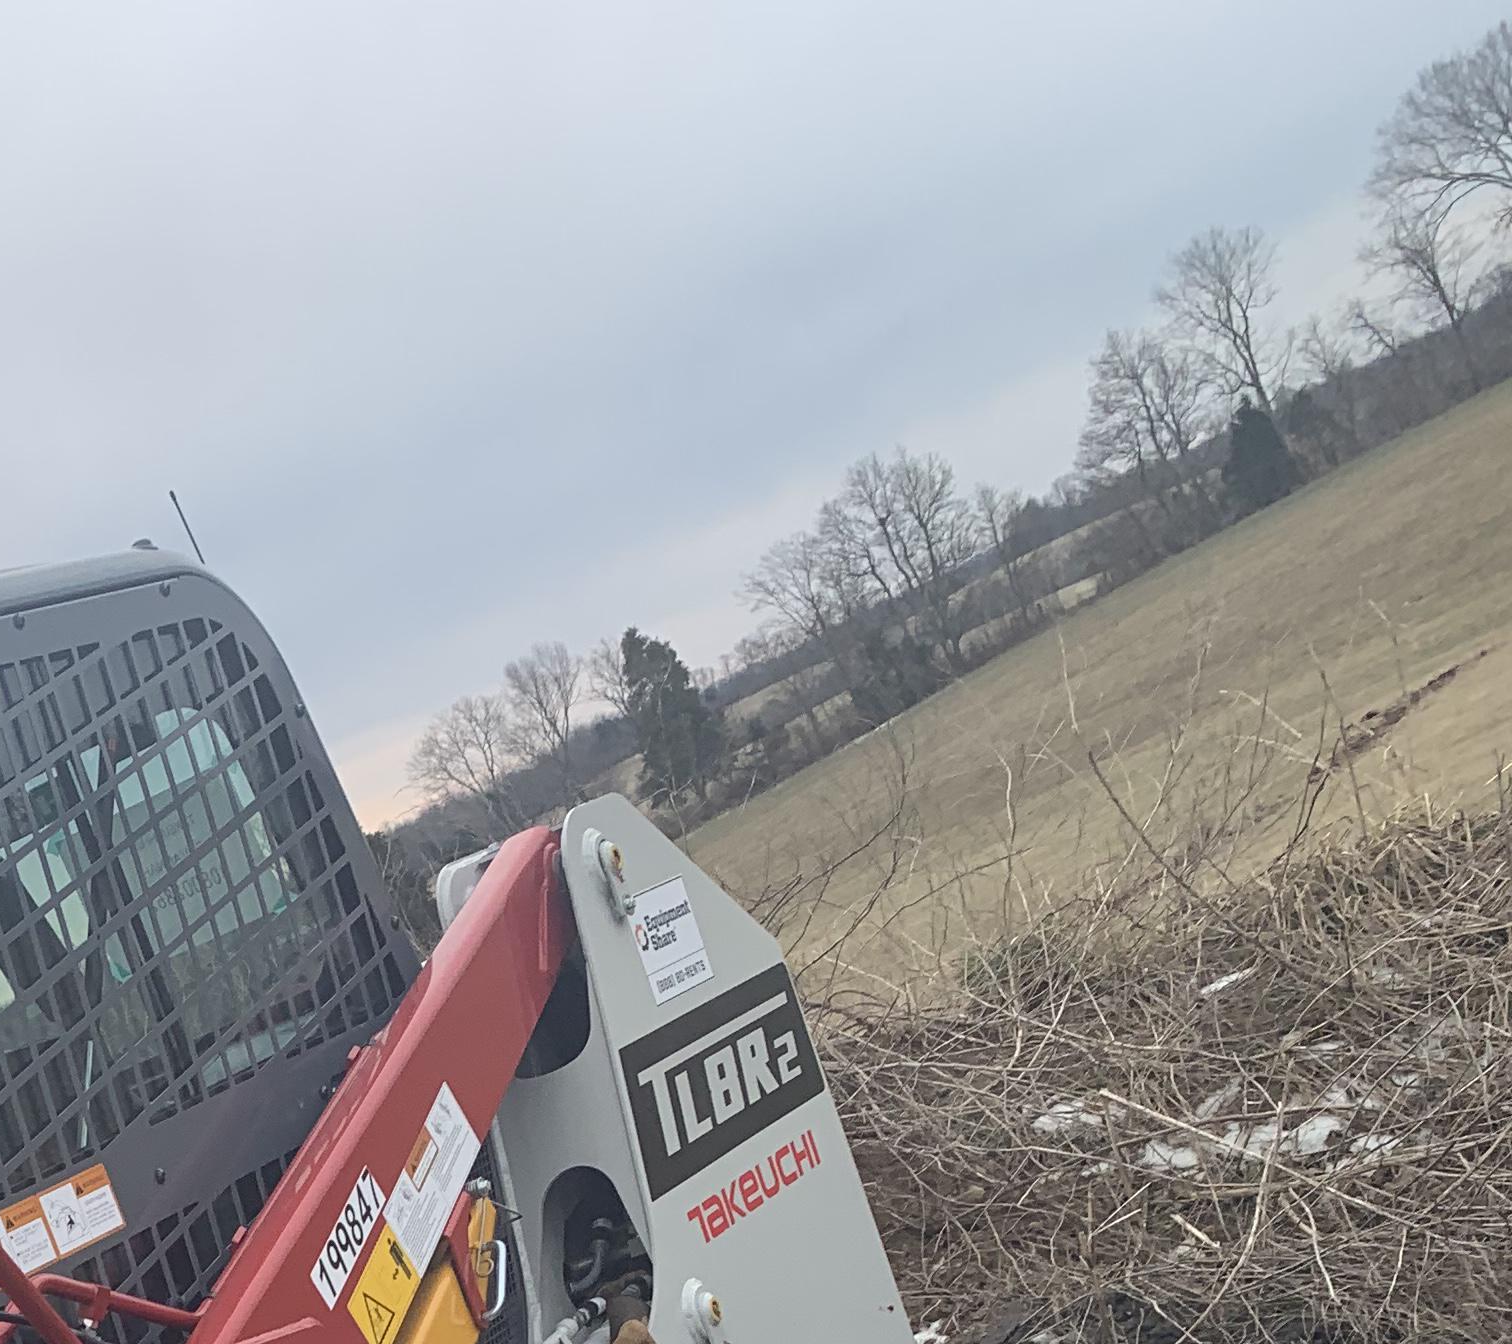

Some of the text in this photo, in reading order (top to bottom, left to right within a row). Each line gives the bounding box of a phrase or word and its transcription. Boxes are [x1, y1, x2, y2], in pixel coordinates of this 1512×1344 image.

[644, 900, 691, 932] Equipment
[650, 930, 677, 951] Share
[637, 991, 802, 1157] TL8R2
[319, 1168, 379, 1297] 199847
[687, 1129, 821, 1243] TAKEUCHI
